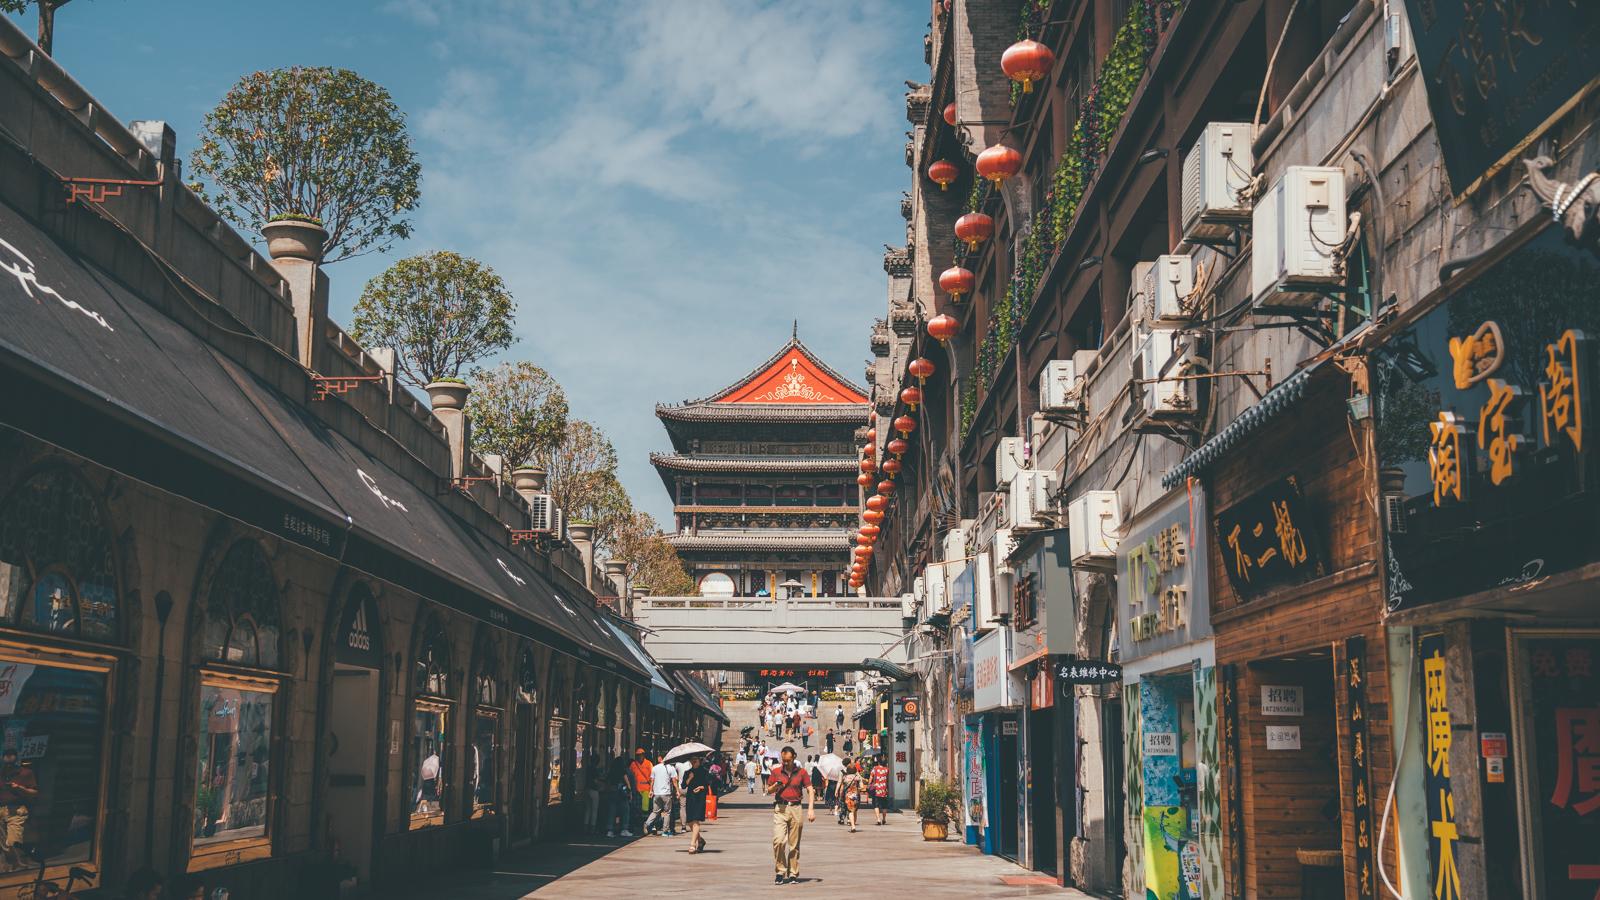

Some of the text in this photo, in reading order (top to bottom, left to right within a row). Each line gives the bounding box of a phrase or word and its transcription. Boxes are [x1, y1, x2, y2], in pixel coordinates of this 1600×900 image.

[349, 631, 370, 651] adidas
[1059, 666, 1119, 679] 名表维修中心
[1267, 687, 1297, 704] 招聘
[1148, 733, 1171, 745] 招聘
